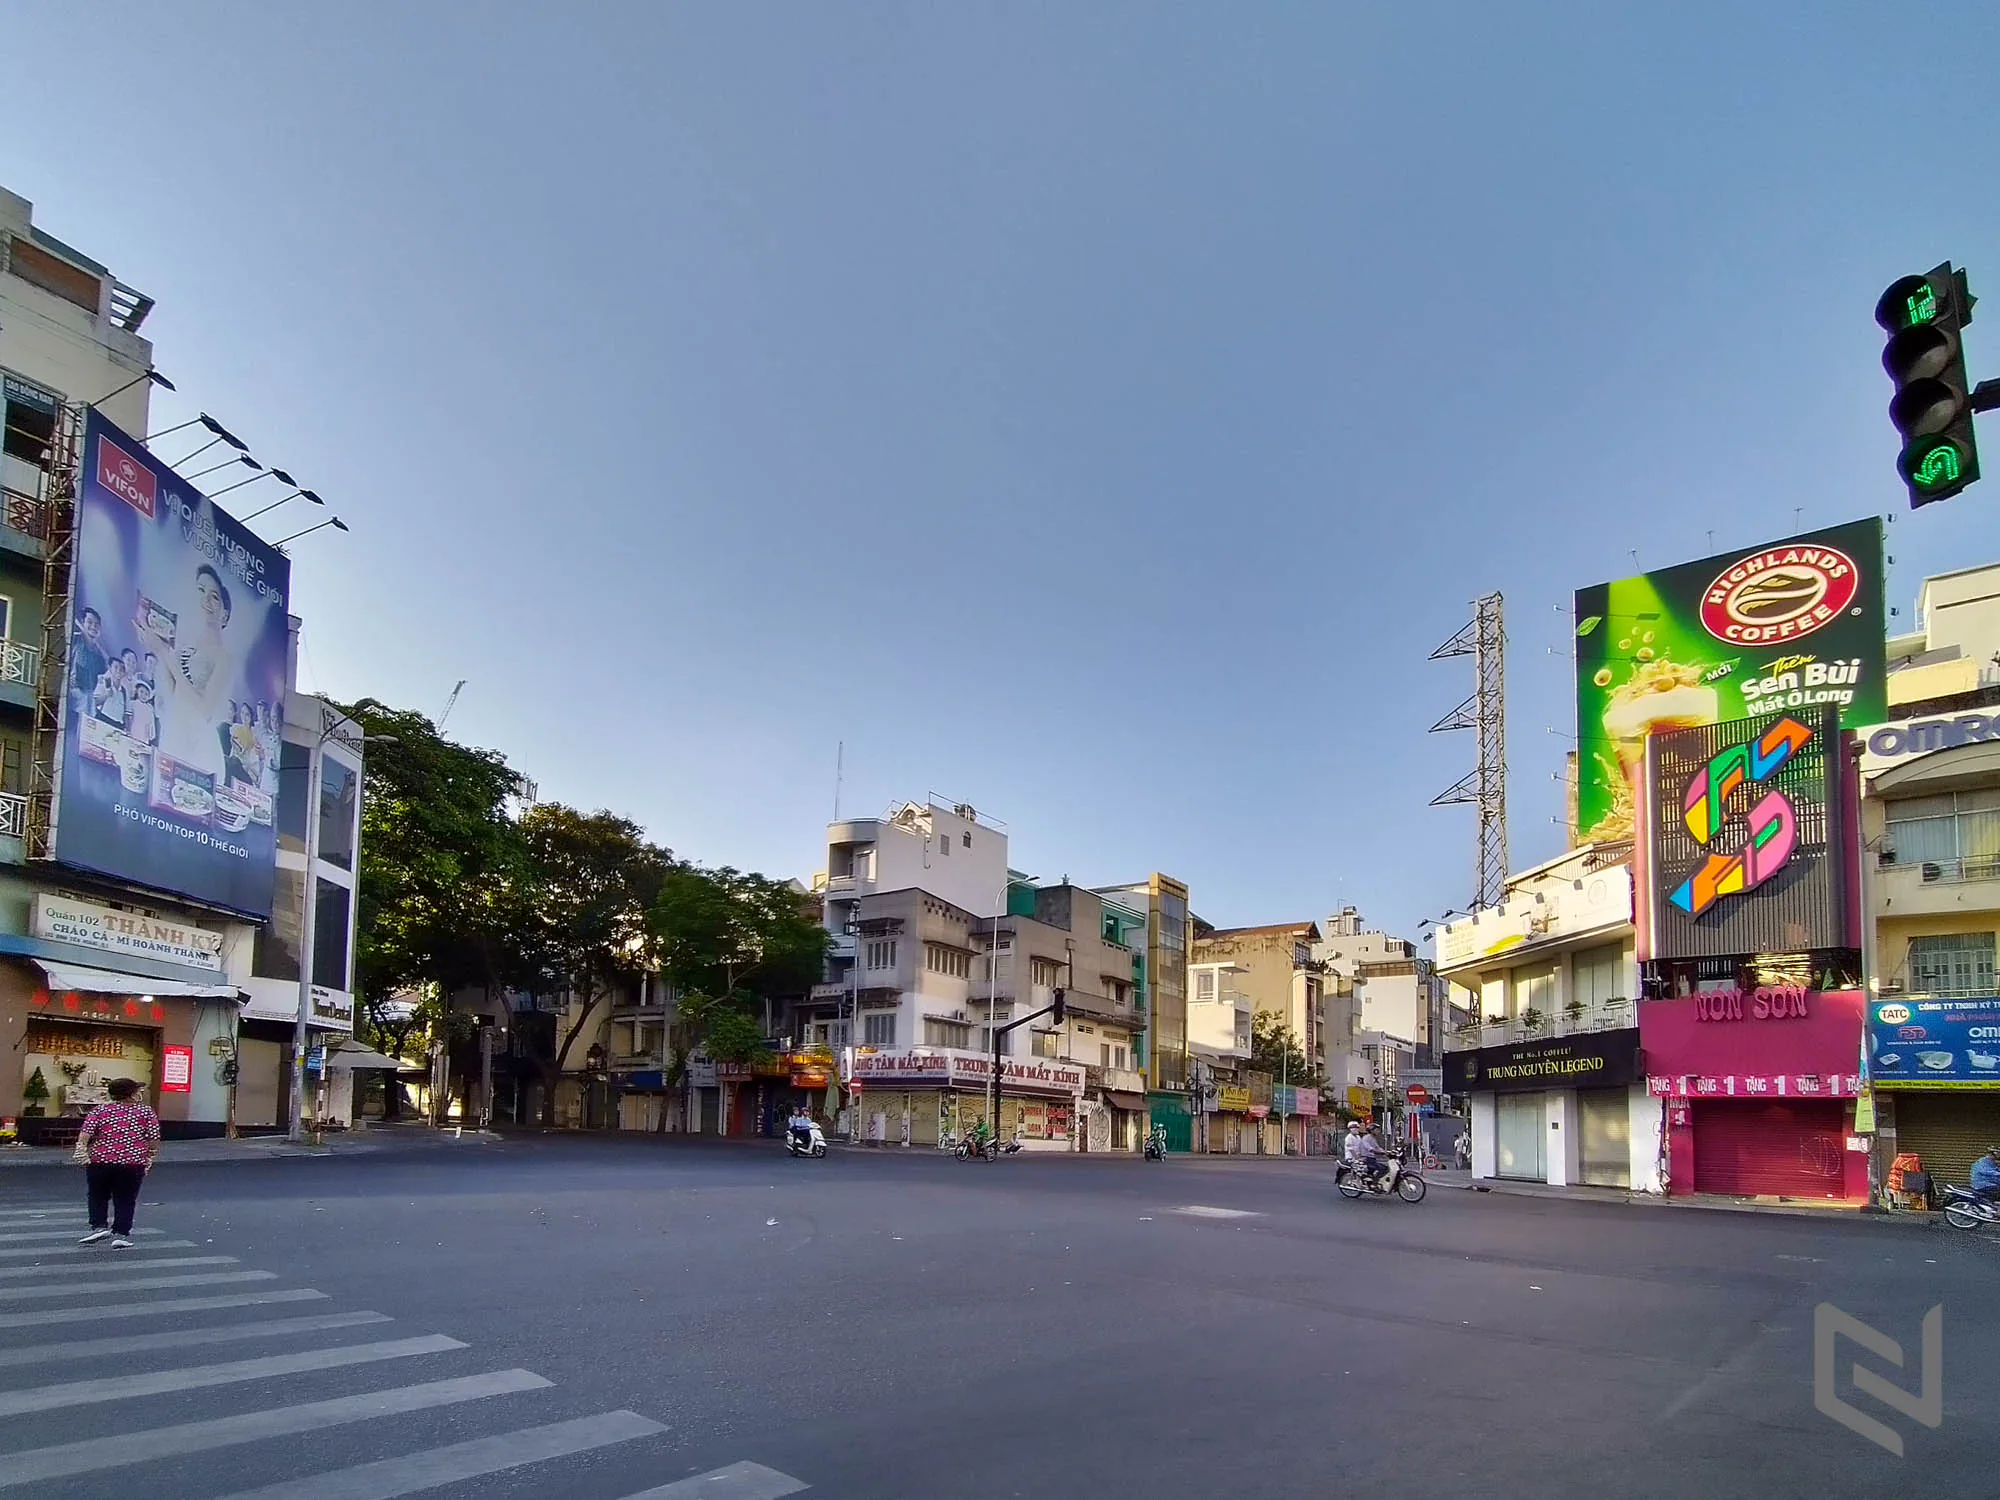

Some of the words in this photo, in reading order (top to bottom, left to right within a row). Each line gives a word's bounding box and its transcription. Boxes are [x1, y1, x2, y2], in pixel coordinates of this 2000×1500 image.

[105, 467, 150, 510] VIFON
[1708, 549, 1849, 605] HIGHLANDS
[1724, 603, 1834, 641] COFFEE
[1705, 662, 1732, 681] MỚI
[1740, 671, 1799, 701] Sen
[1804, 658, 1861, 687] Bùi
[1745, 694, 1786, 717] Mát
[1787, 689, 1803, 707] Ô
[1804, 688, 1854, 705] Long
[141, 813, 174, 834] VIFON
[174, 824, 196, 840] TOP
[196, 831, 209, 845] 10
[209, 837, 229, 852] THẾ
[46, 907, 77, 923] Quán
[79, 913, 99, 927] 102
[102, 915, 185, 945] THÀNH
[53, 923, 88, 937] CHÁO
[132, 938, 171, 954] HOÀNH
[1694, 981, 1744, 1021] NÓN
[1752, 982, 1808, 1020] SƠN
[1881, 1009, 1908, 1020] TATC
[1053, 1067, 1081, 1085] KÍNH
[1487, 1064, 1518, 1079] TRUNG
[1518, 1059, 1560, 1078] NGUYÊN
[1560, 1057, 1604, 1074] LEGEND
[1650, 1076, 1671, 1095] TẶNG
[1676, 1075, 1687, 1095] 1
[1696, 1076, 1717, 1095] TẶNG
[1723, 1075, 1734, 1095] 1
[1745, 1075, 1767, 1095] TẶNG
[1774, 1075, 1786, 1095] 1
[1796, 1075, 1820, 1095] TẶNG
[1827, 1075, 1839, 1095] 1
